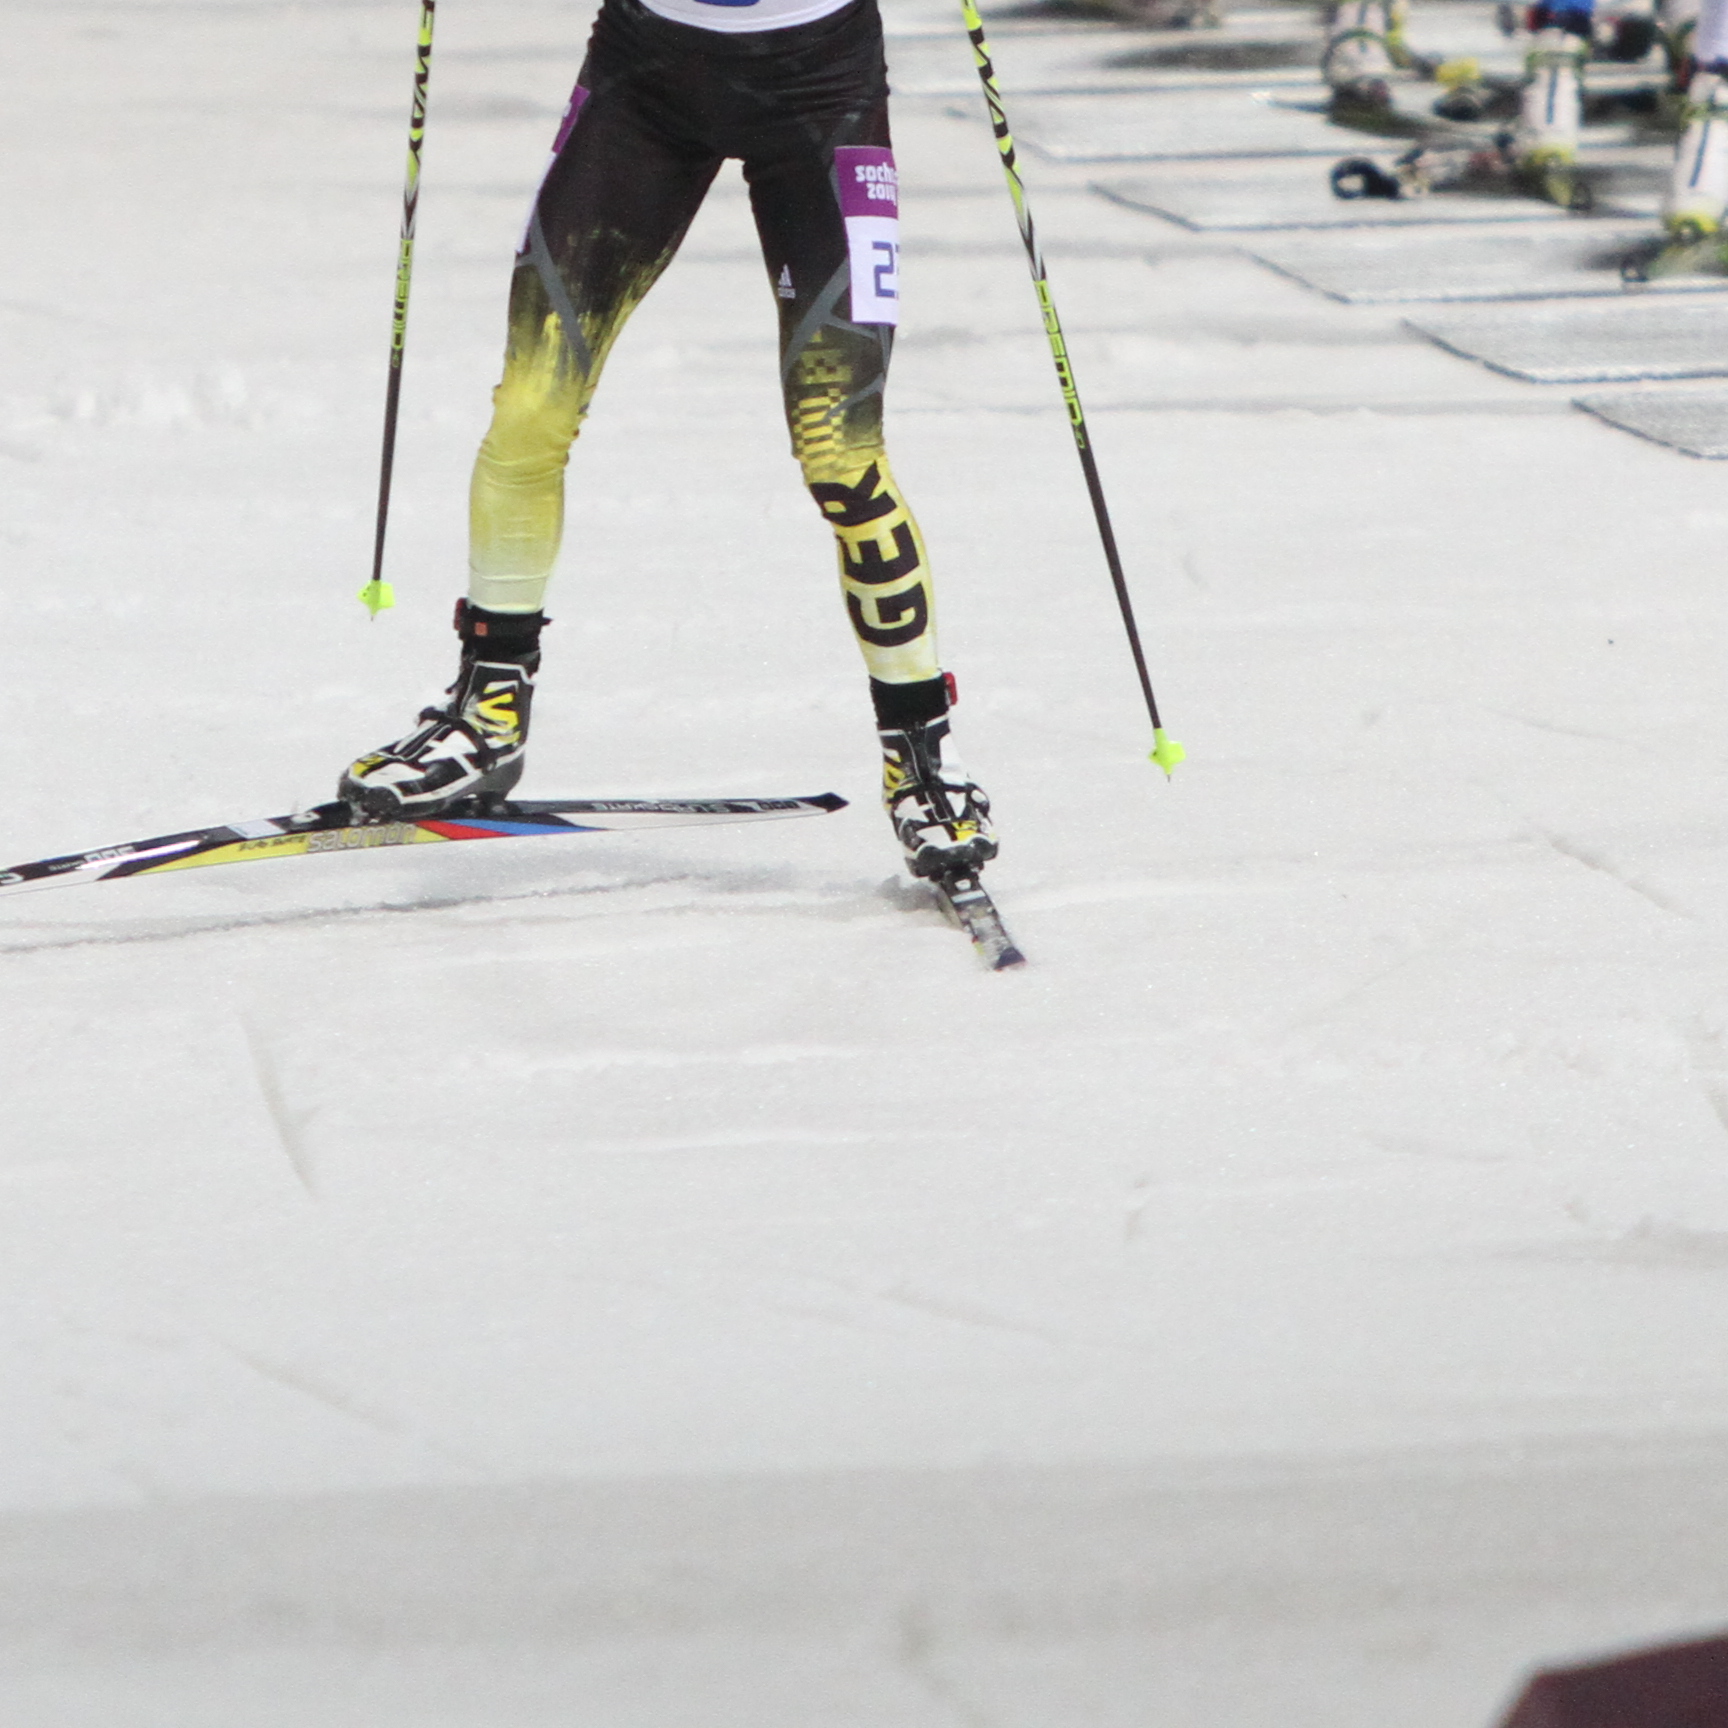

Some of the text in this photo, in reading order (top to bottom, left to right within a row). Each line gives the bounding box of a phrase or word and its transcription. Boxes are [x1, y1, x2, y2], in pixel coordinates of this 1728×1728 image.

[872, 240, 899, 300] 2
[808, 458, 929, 648] GER
[306, 821, 418, 853] salomon
